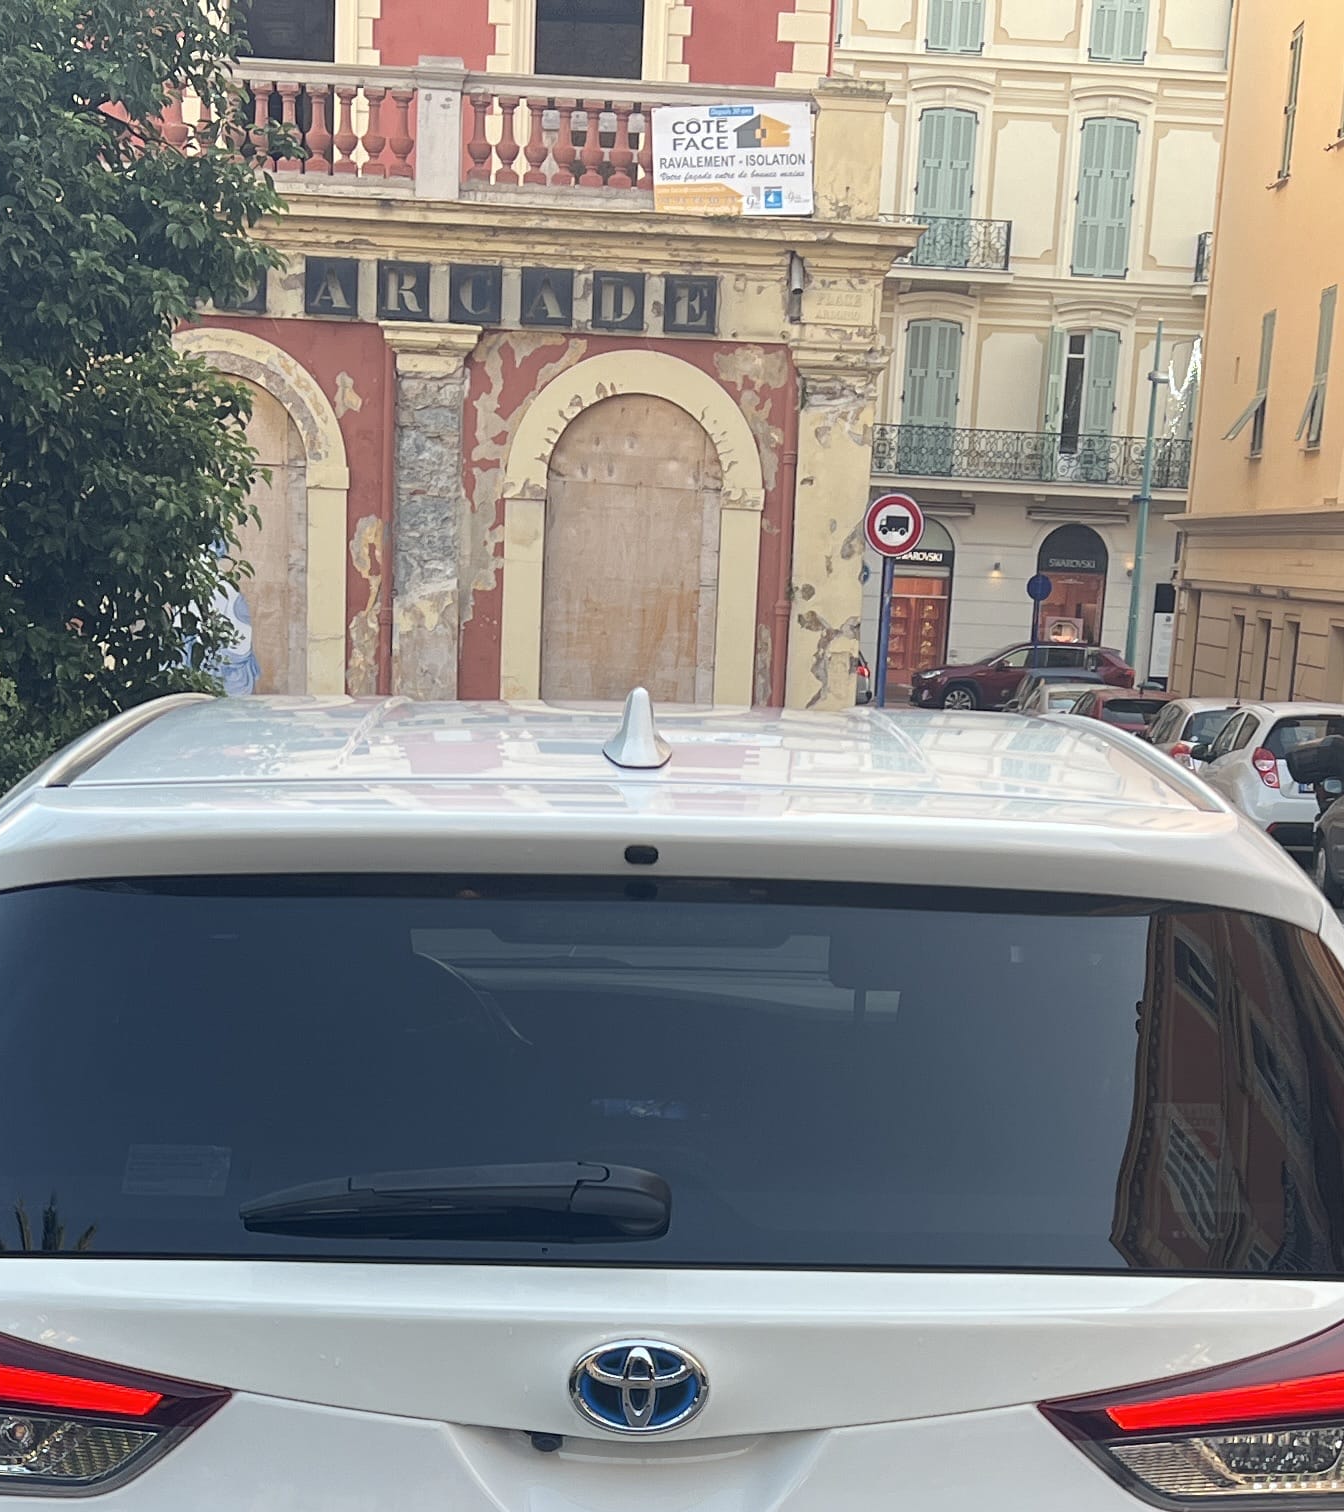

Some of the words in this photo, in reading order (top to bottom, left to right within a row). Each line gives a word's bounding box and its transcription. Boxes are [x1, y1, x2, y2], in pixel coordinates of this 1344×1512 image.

[672, 136, 729, 151] FACE
[659, 155, 736, 169] RAVALEMENT
[745, 154, 806, 167] ISOLATION
